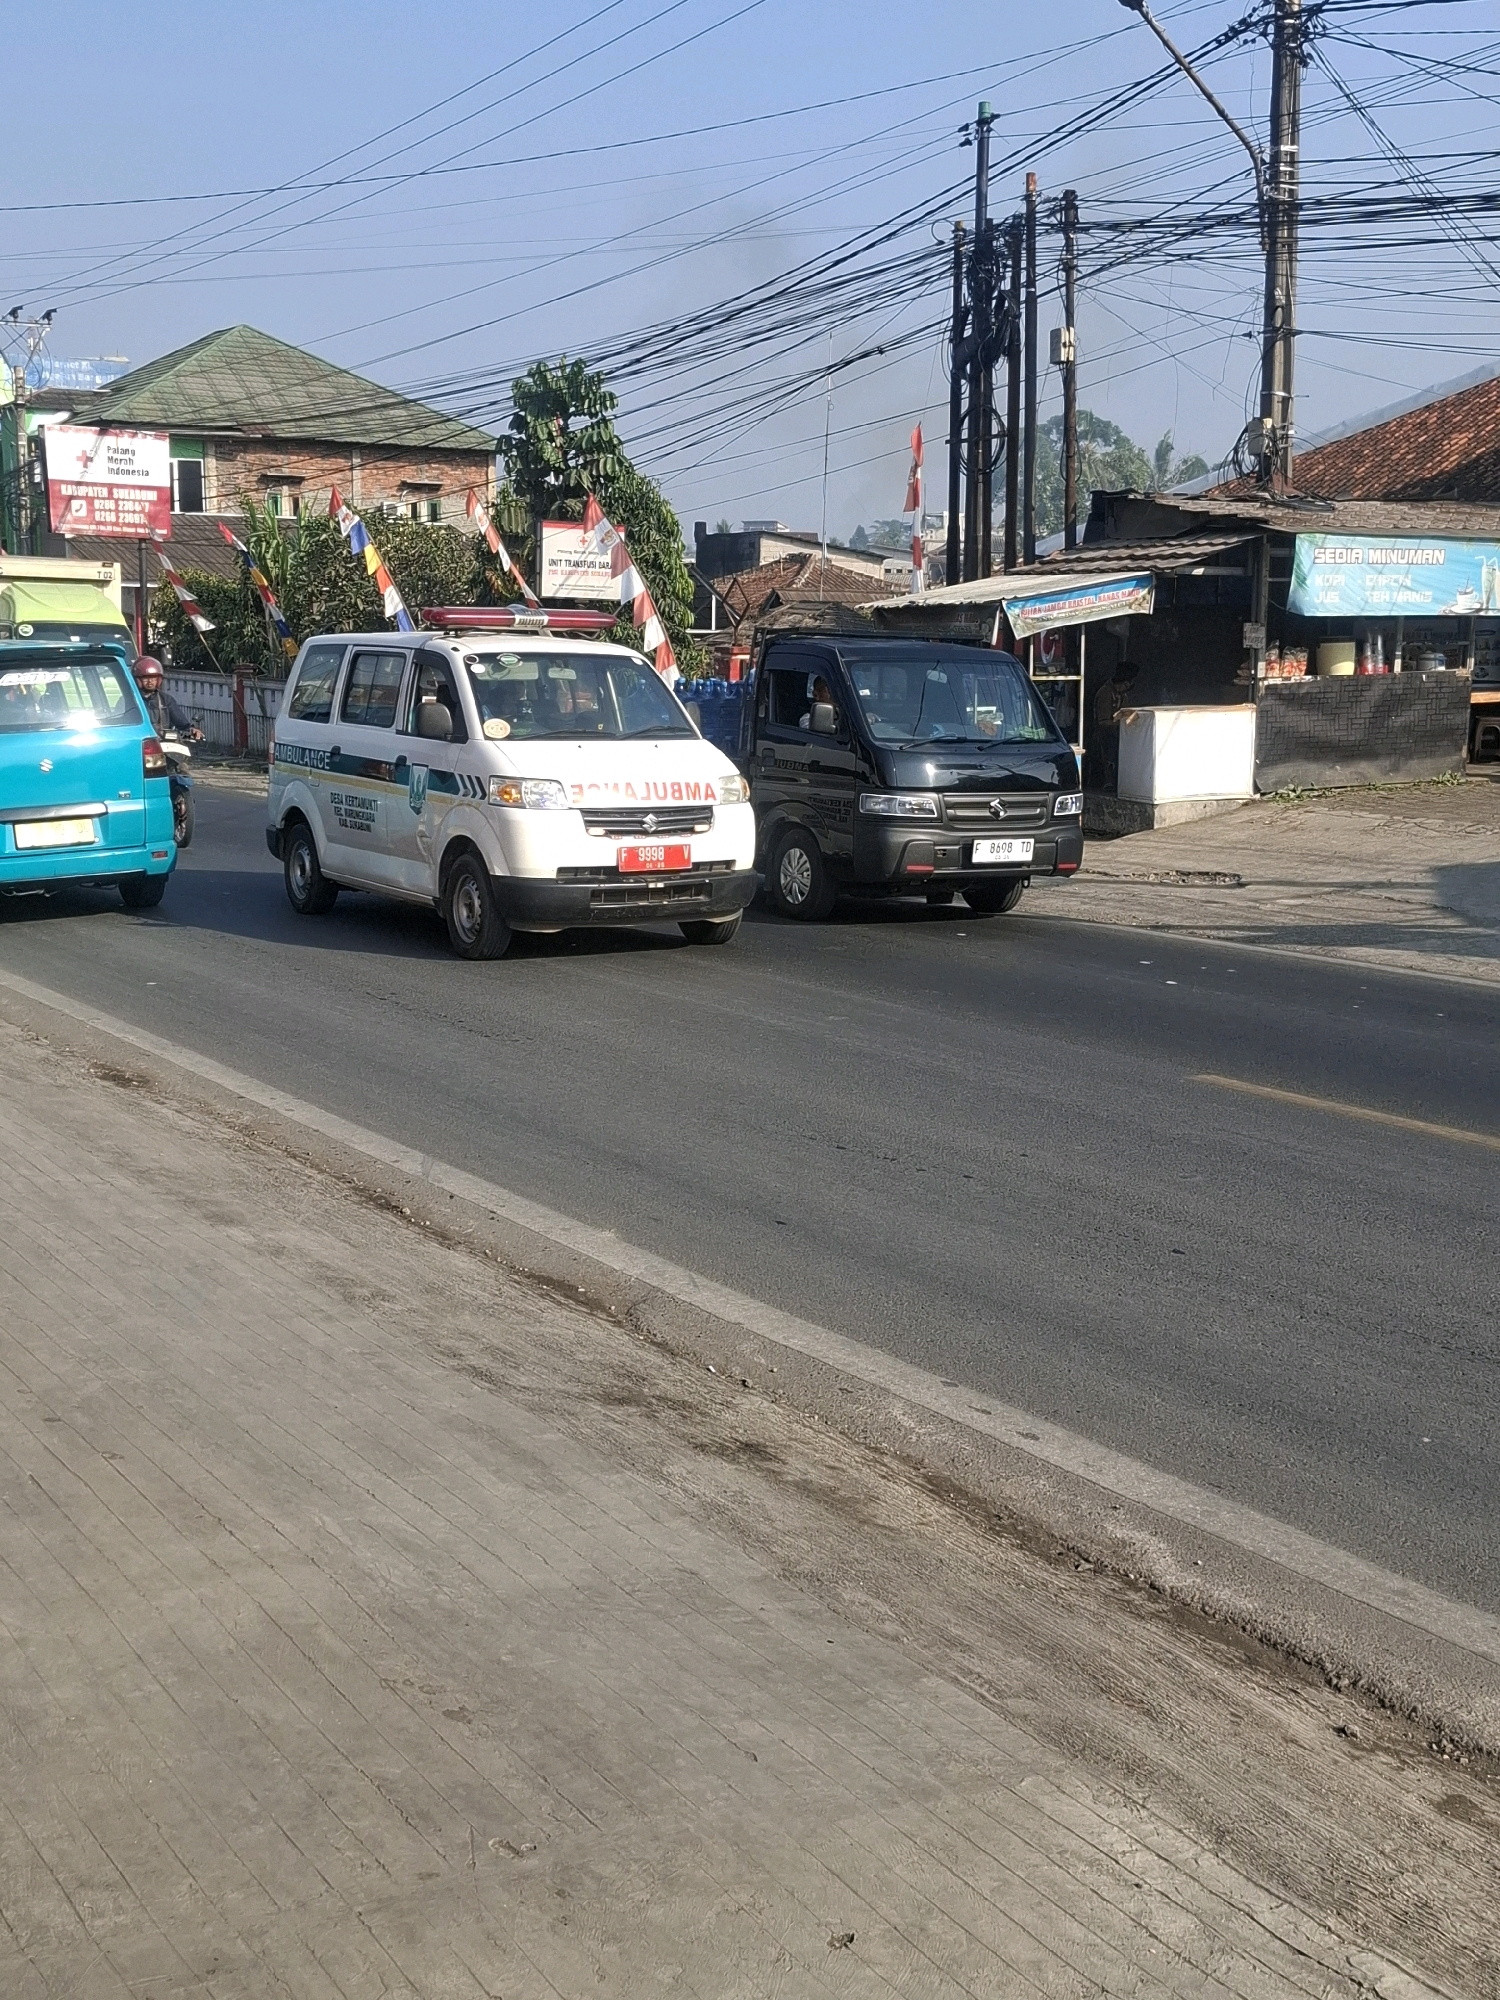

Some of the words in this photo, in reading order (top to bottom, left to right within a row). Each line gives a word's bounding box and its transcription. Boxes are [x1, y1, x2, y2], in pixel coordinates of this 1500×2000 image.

[107, 446, 136, 457] Palang
[107, 456, 134, 466] Merah
[107, 466, 149, 477] Indonesia
[60, 484, 108, 498] KABUPATEN
[113, 488, 158, 501] SUKABUMI
[1313, 547, 1364, 565] SEDIA
[1367, 548, 1446, 566] MINUMAN
[548, 558, 562, 568] UNIT
[564, 559, 596, 569] TRANSFUSI
[97, 571, 102, 579] T
[103, 571, 113, 579] 02
[1314, 574, 1345, 587] KOPI
[1314, 591, 1339, 603] JUS
[1366, 591, 1390, 603] TEH
[1393, 591, 1433, 603] MANIS
[275, 744, 331, 770] AMBULANCE
[330, 792, 344, 805] DESA
[344, 794, 379, 813] KERTAMUKTI
[349, 819, 372, 833] SUKABUMI
[621, 848, 628, 863] F
[638, 846, 664, 862] 9998
[682, 845, 689, 860] V
[975, 842, 981, 854] F
[990, 841, 1013, 854] 8698
[1021, 841, 1032, 853] TD
